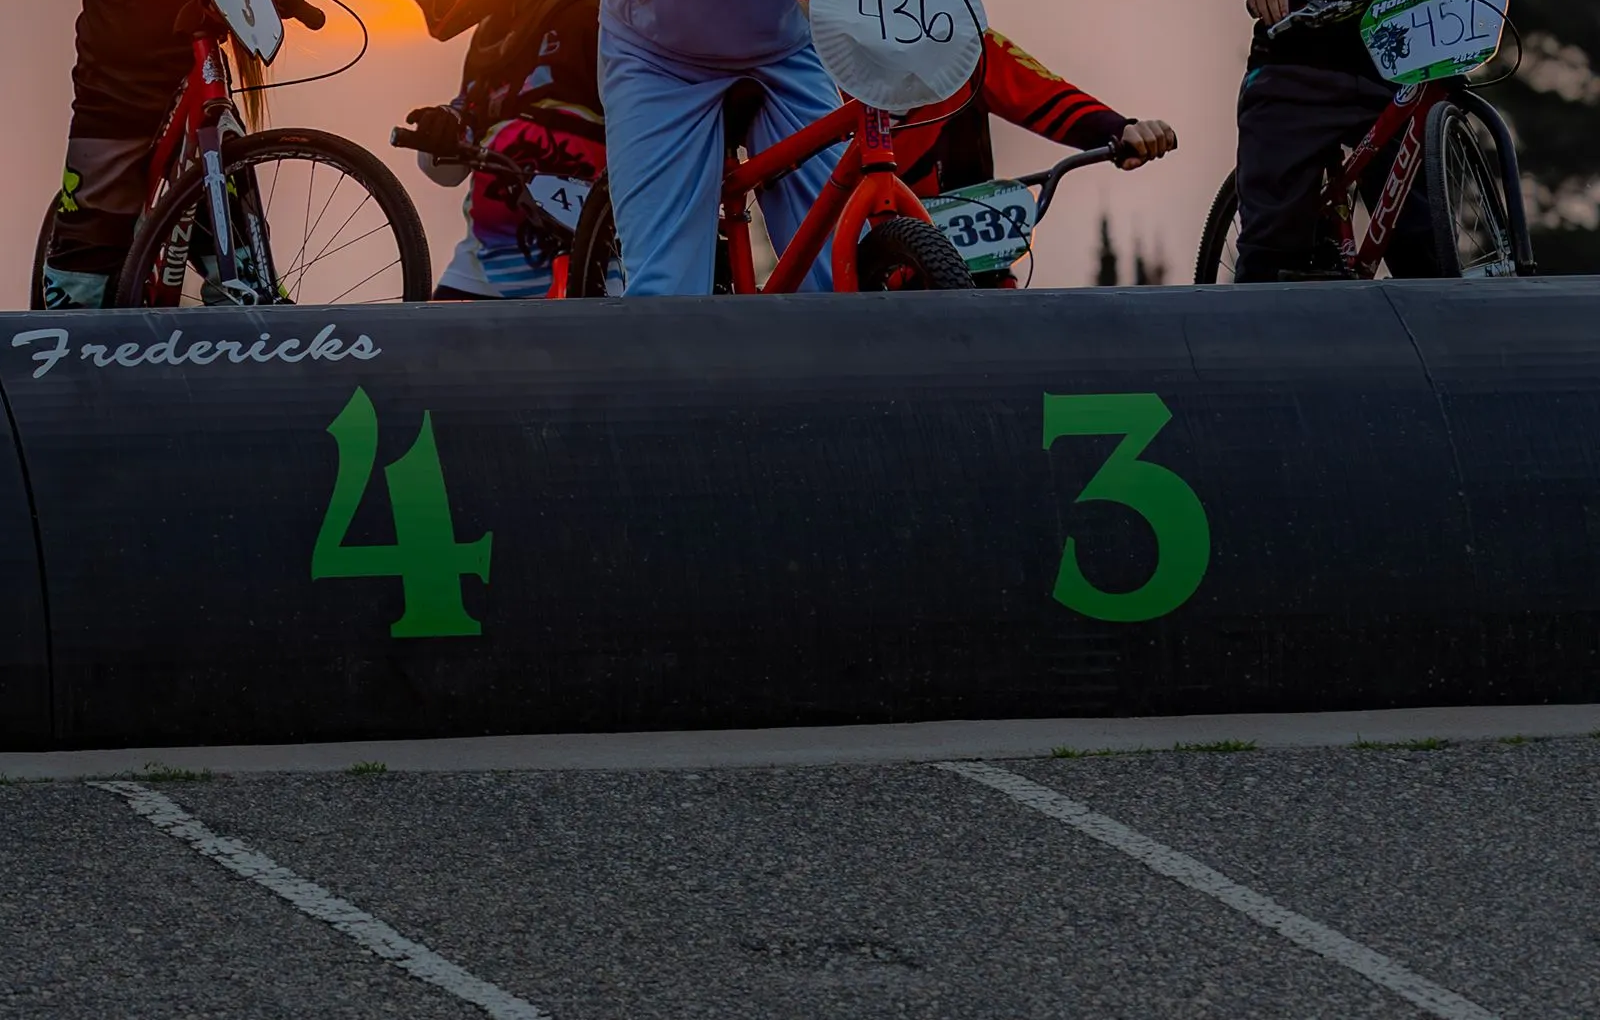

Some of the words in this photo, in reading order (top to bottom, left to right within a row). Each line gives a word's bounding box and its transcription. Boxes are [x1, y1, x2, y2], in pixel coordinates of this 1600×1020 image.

[948, 205, 1031, 248] 332
[11, 324, 382, 379] Fredericks
[311, 386, 493, 638] 4
[1043, 393, 1211, 622] 3
